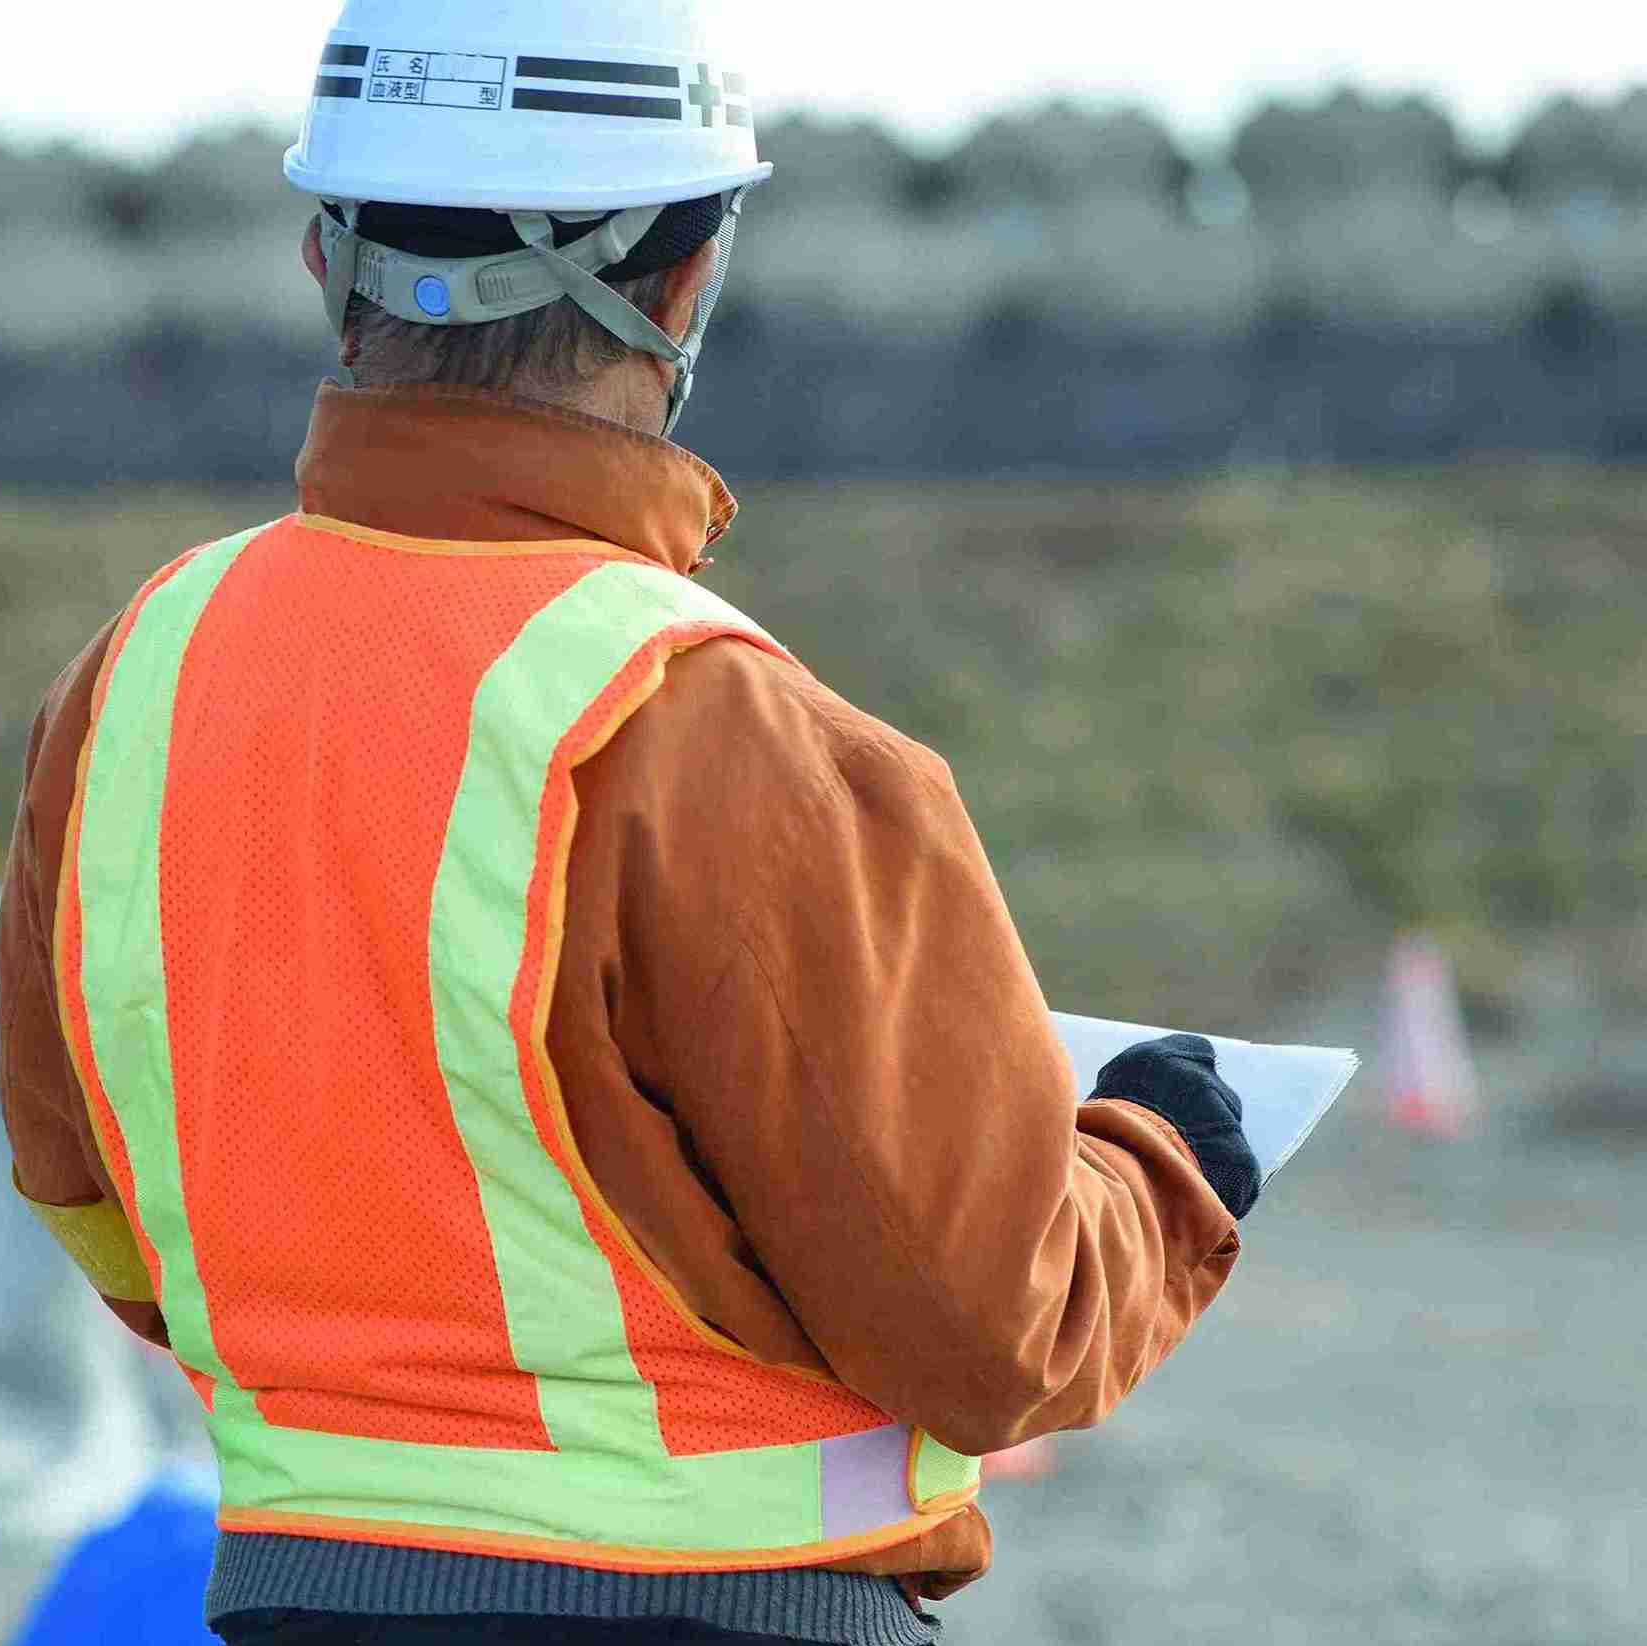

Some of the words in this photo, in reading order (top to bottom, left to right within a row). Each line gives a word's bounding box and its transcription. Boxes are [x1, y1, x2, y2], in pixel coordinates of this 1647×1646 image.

[371, 80, 419, 100] 血液型
[478, 86, 498, 105] 型
